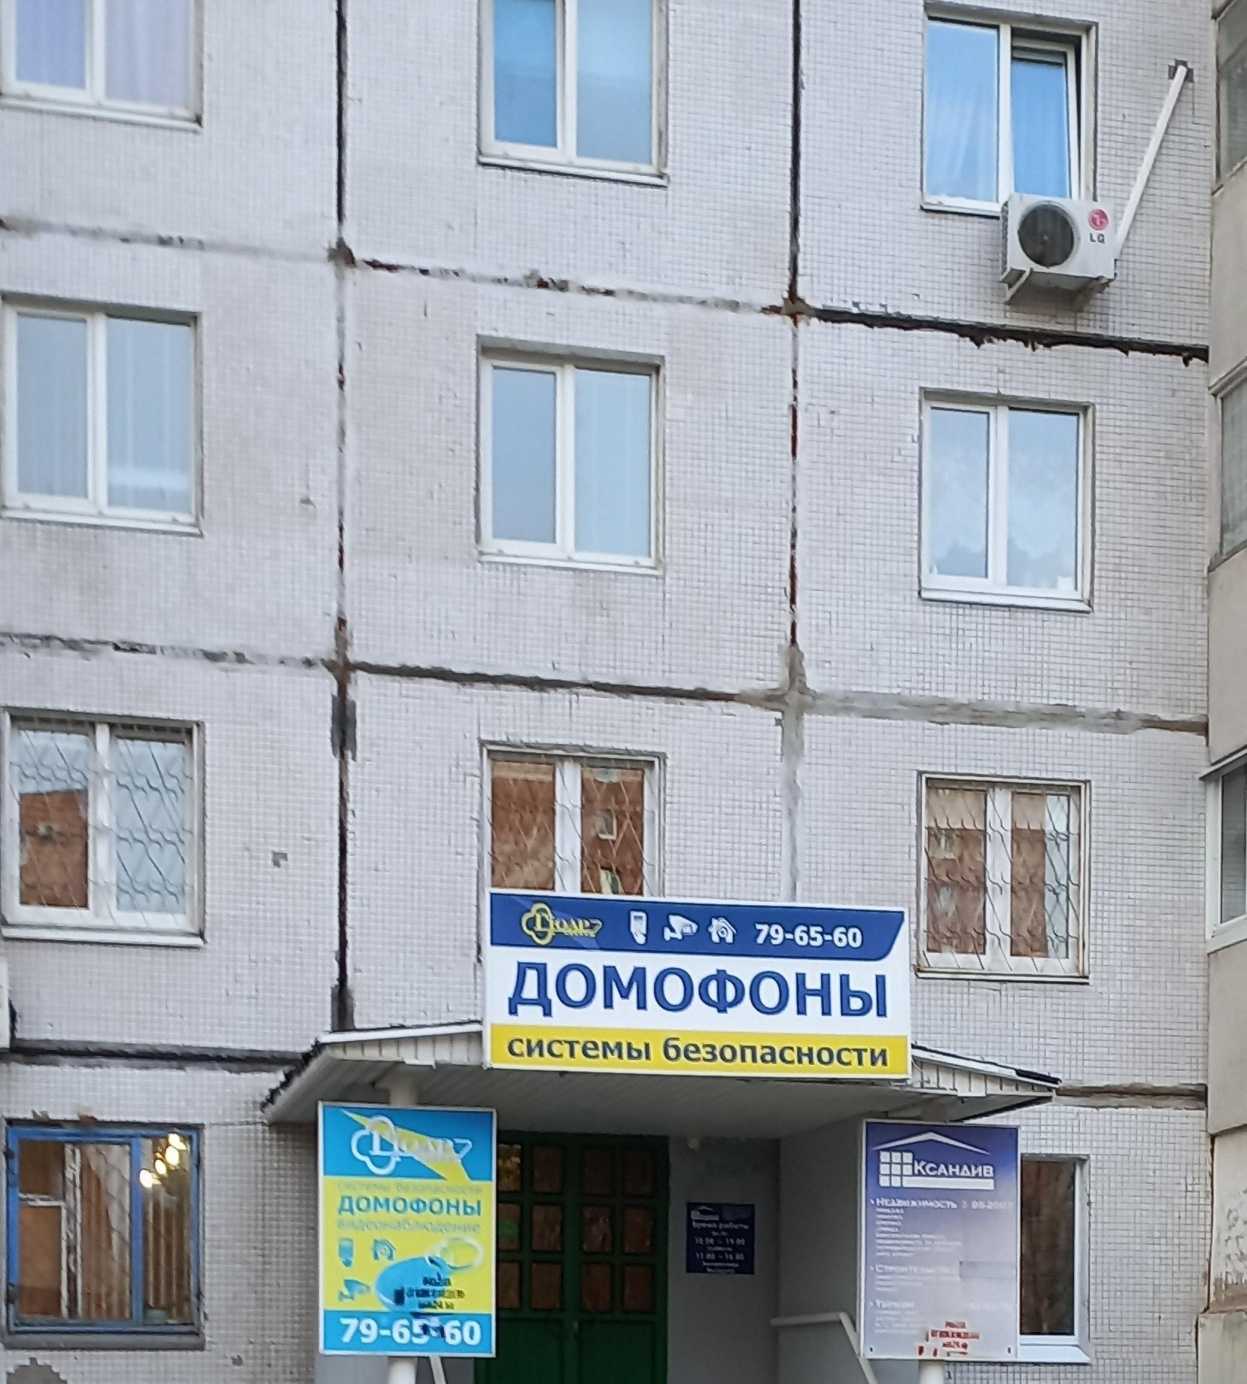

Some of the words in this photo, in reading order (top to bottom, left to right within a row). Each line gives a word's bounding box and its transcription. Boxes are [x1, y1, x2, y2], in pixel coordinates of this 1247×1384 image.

[1088, 233, 1105, 243] LG
[755, 923, 863, 948] 79-65-60
[507, 961, 888, 1018] ДОМОФОНЫ
[507, 1036, 651, 1061] системы
[662, 1037, 889, 1067] безопасности
[338, 1195, 481, 1217] ДОМОФОНЫ
[339, 1317, 481, 1346] 79-65-60
